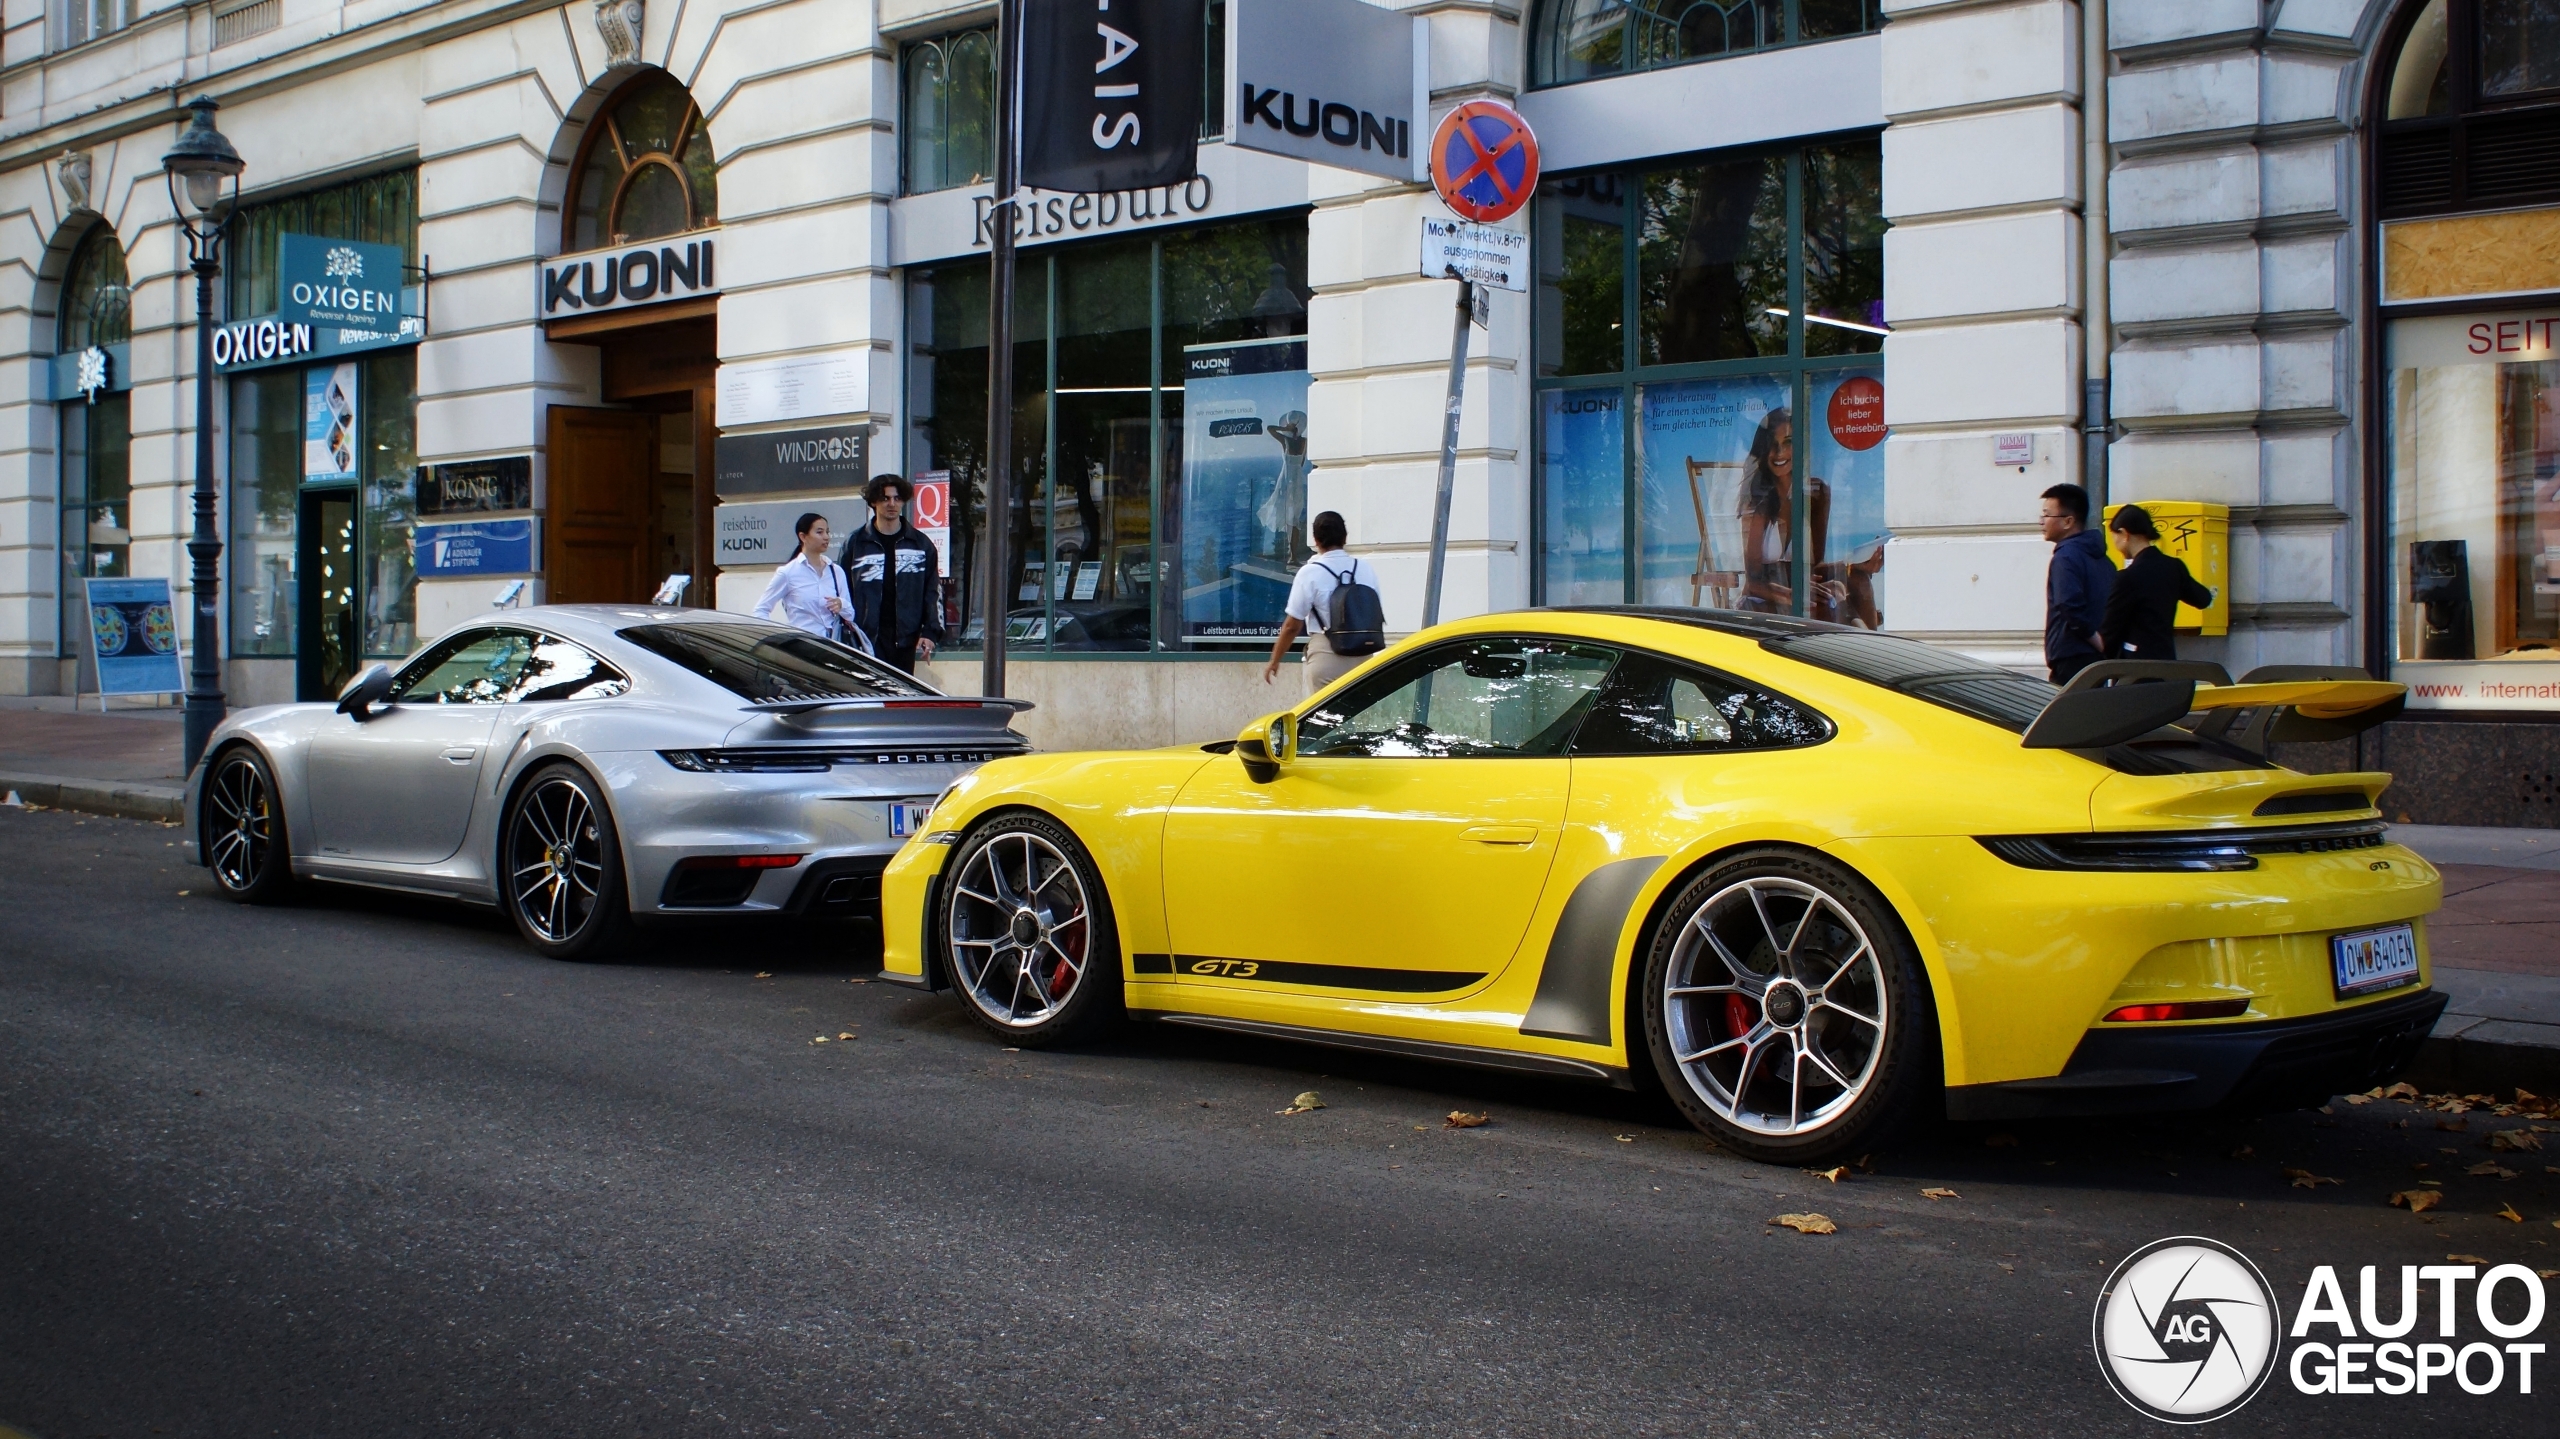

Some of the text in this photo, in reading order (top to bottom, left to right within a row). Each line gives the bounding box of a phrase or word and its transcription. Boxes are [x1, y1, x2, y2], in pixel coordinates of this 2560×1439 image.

[1092, 0, 1141, 149] AIS
[1243, 83, 1408, 158] KUONI
[1443, 246, 1511, 265] ausgenommen
[545, 240, 713, 313] KUONI
[1446, 262, 1508, 283] detätigkei
[293, 283, 393, 314] OXIGEN
[310, 309, 376, 325] Reverse Ageing
[213, 320, 310, 366] OXIGEN
[2468, 318, 2560, 355] SEIT
[1192, 357, 1230, 370] KUONI
[1554, 398, 1618, 415] KUONI
[1652, 392, 1717, 405] Mehr Beratung
[1840, 395, 1880, 405] Ich buche
[1237, 406, 1254, 414] Urlaub
[1651, 401, 1770, 419] für einen schöneren Urlaub,
[1848, 410, 1871, 419] lieber
[1652, 417, 1733, 432] zum gleichen Preis!
[1833, 422, 1886, 434] im Reisebüro
[776, 436, 859, 464] WINDROSE
[804, 462, 859, 473] FINEST TRAVEL
[446, 475, 498, 500] KÖNIG
[723, 516, 767, 531] reisebüro
[452, 548, 482, 557] ADENAUER
[722, 538, 767, 551] KUONI
[452, 558, 479, 567] STIFTUNG
[1203, 626, 1237, 635] Leistbarer
[1238, 626, 1258, 635] Luxus
[1259, 626, 1269, 635] für
[2415, 684, 2468, 698] www.
[877, 753, 993, 764] PORSCHE
[912, 808, 924, 830] W
[1031, 820, 1075, 852] MICHELIN
[2369, 861, 2390, 871] GT3
[1664, 877, 1710, 935] MICHELIN
[1191, 959, 1259, 977] GT3
